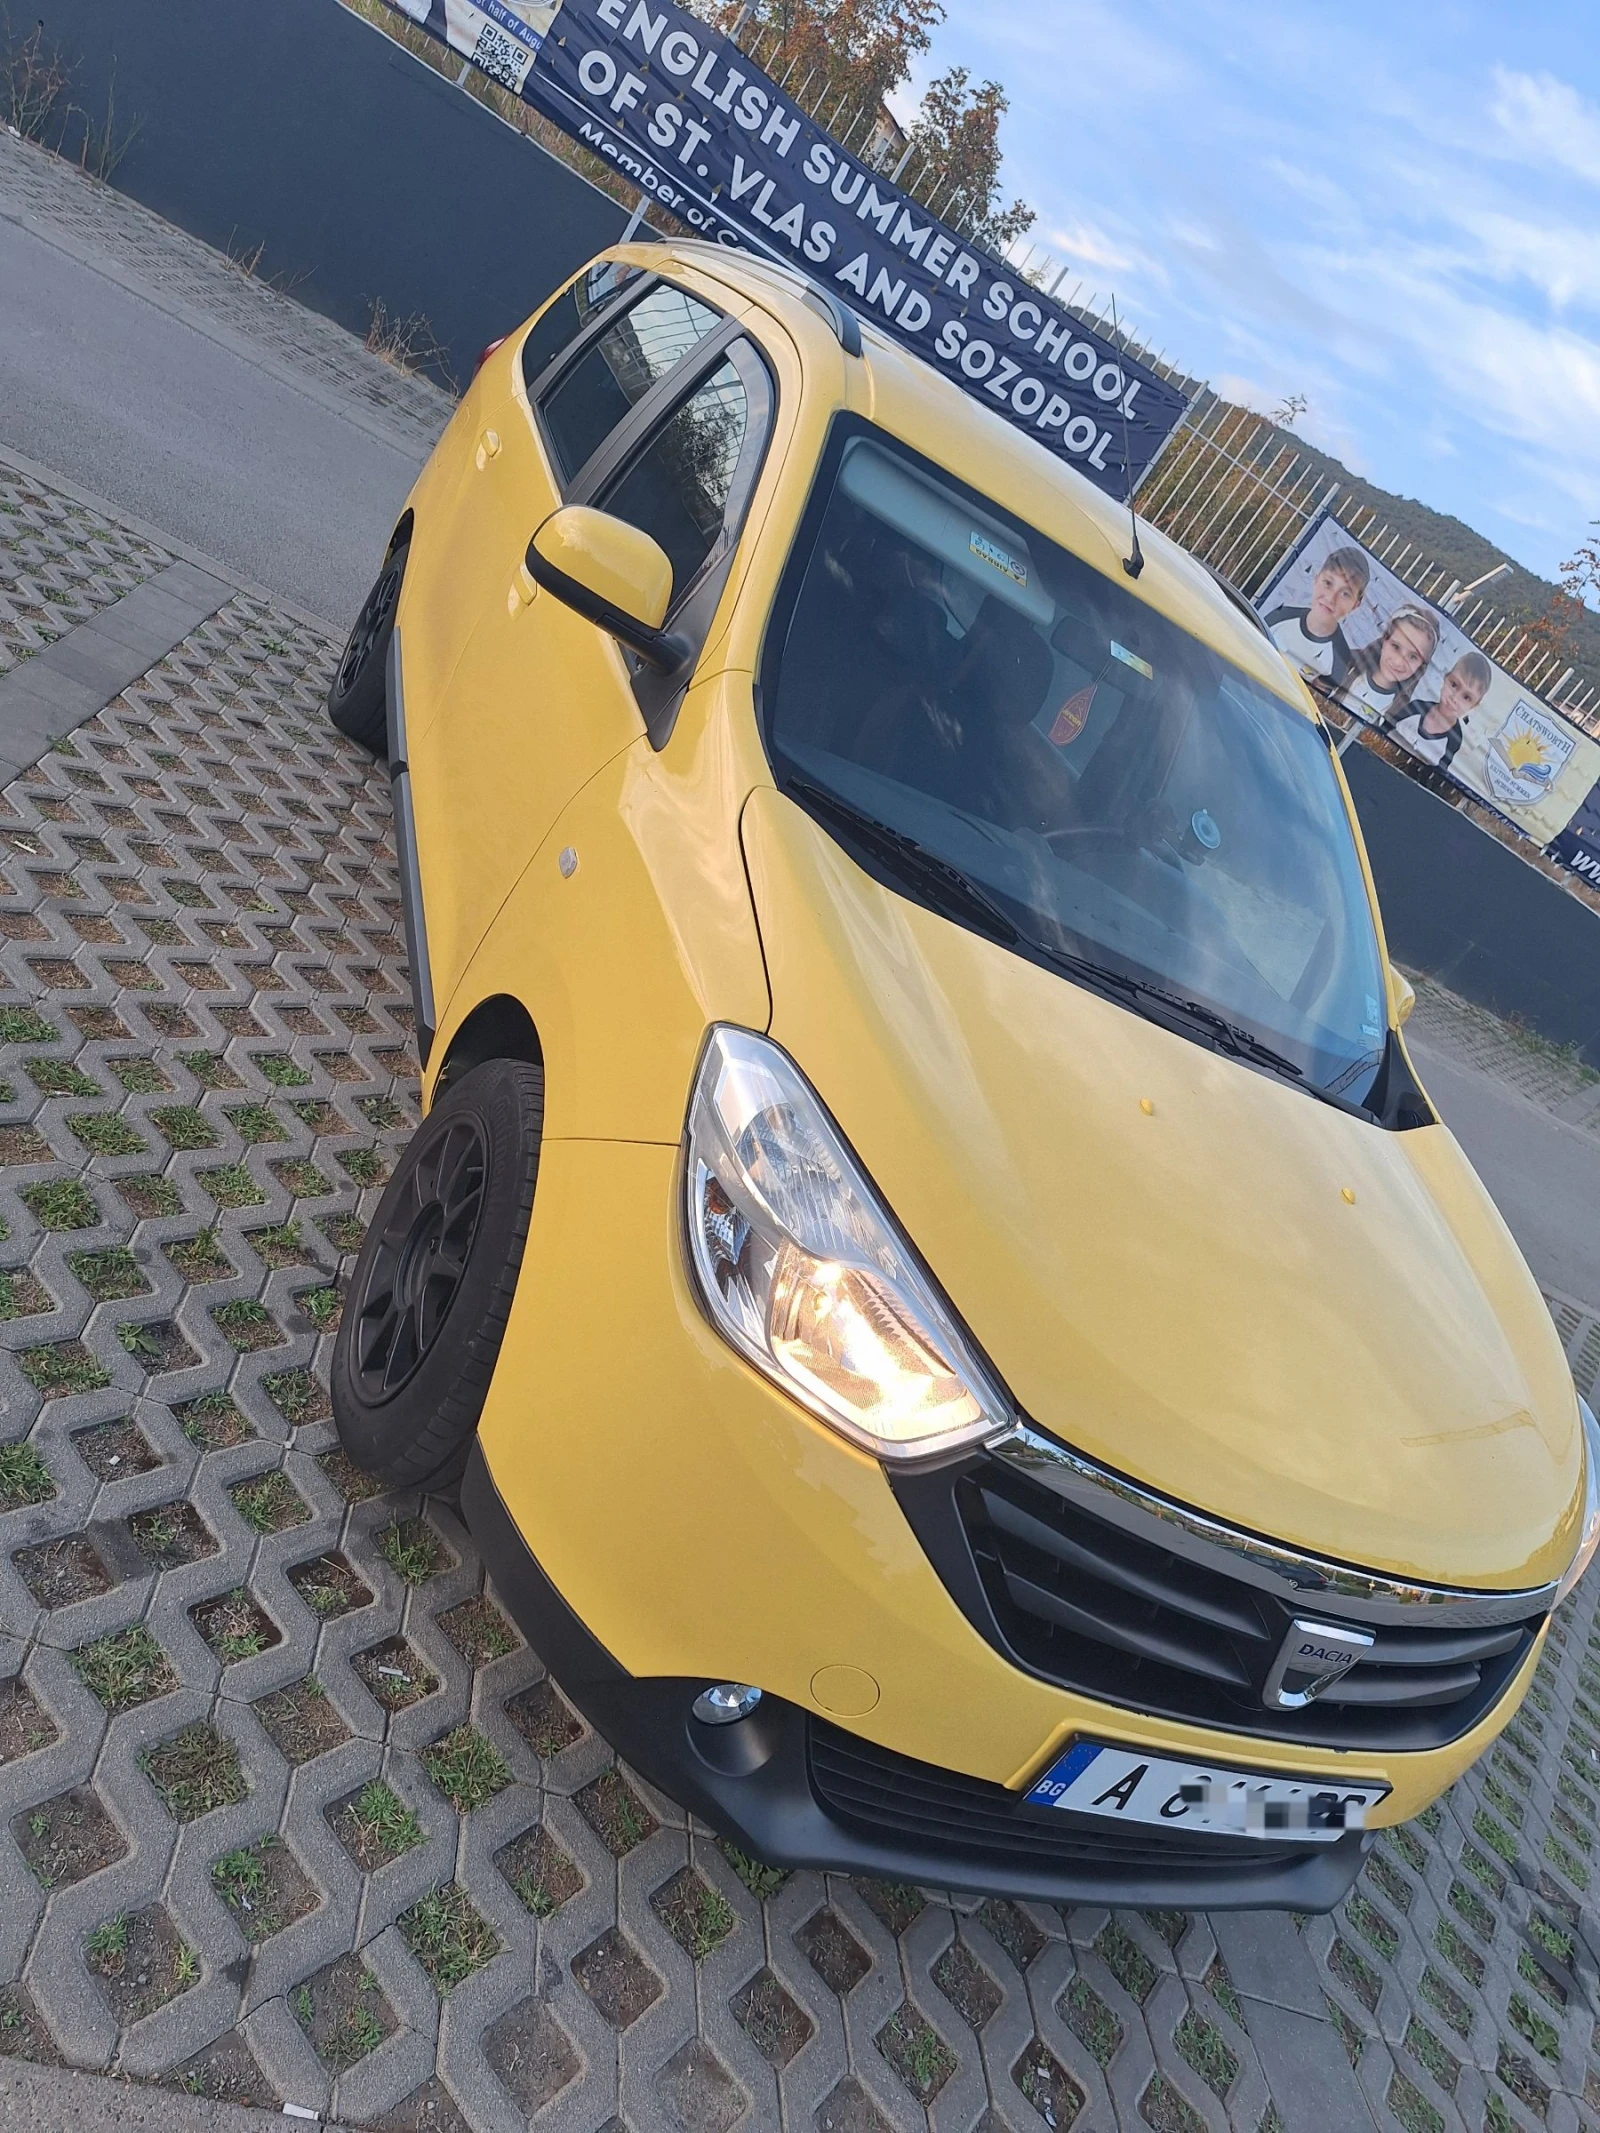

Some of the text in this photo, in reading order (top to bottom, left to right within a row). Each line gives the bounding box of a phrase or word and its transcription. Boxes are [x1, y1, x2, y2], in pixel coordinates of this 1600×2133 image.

[488, 0, 507, 21] half
[507, 19, 519, 31] of
[578, 122, 685, 209] Member
[686, 208, 717, 231] of
[596, 0, 1143, 420] ENGLISH SUMMER SCHOOL
[578, 50, 1115, 472] OF ST. VLAS AND SOZOPOL
[1514, 705, 1572, 755] CHATSWORTH
[1298, 1643, 1353, 1664] DACIA
[1035, 1779, 1067, 1797] BG
[1090, 1763, 1150, 1810] A
